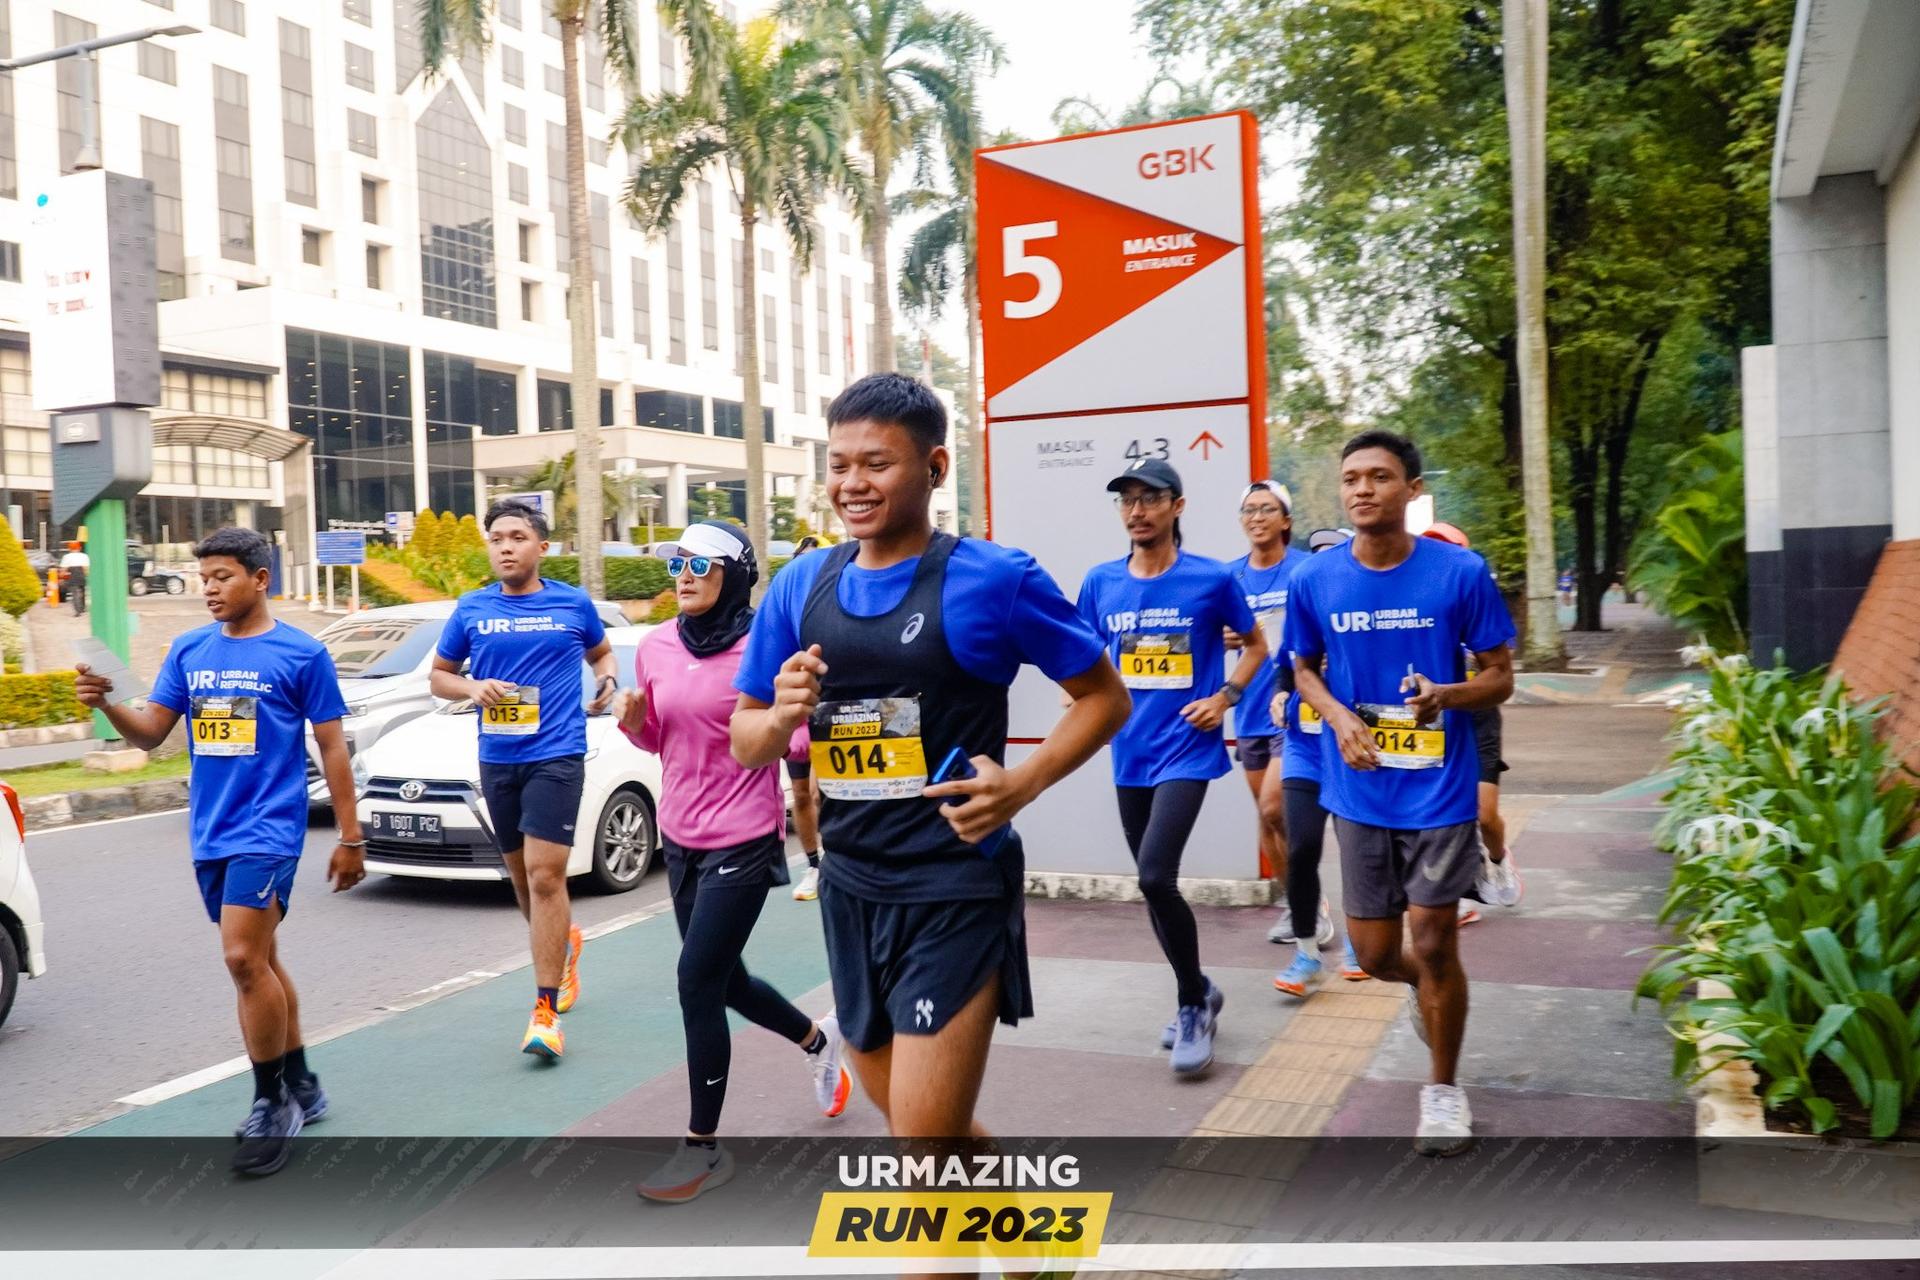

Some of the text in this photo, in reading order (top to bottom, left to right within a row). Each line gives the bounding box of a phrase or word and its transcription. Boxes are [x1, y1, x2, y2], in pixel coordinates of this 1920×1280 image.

[1138, 144, 1215, 179] GBK
[1123, 232, 1198, 254] MASUK
[1002, 220, 1063, 319] 5
[1124, 254, 1197, 272] ENTRANCE
[1037, 438, 1170, 461] MASUK 4-3
[1038, 456, 1094, 469] ENTRANCE
[1141, 608, 1179, 617] URBAN
[1375, 608, 1417, 618] URBAN
[478, 619, 510, 634] UR
[515, 624, 566, 632] REPUBLIC
[1107, 611, 1137, 632] UR
[1141, 617, 1193, 627] REPUBLIC
[1331, 612, 1370, 632] UR
[1376, 618, 1435, 629] REPUBLIC
[1134, 658, 1169, 673] 014
[186, 670, 215, 690] UR
[221, 671, 259, 679] URBAN
[220, 681, 272, 692] REPUBLIC
[489, 707, 518, 721] 013
[832, 713, 880, 724] URMAZING
[199, 722, 230, 739] 013
[834, 725, 877, 736] RUN 2023
[1375, 731, 1416, 751] 014
[829, 744, 887, 774] 014
[373, 814, 381, 828] B
[389, 815, 412, 829] 1607
